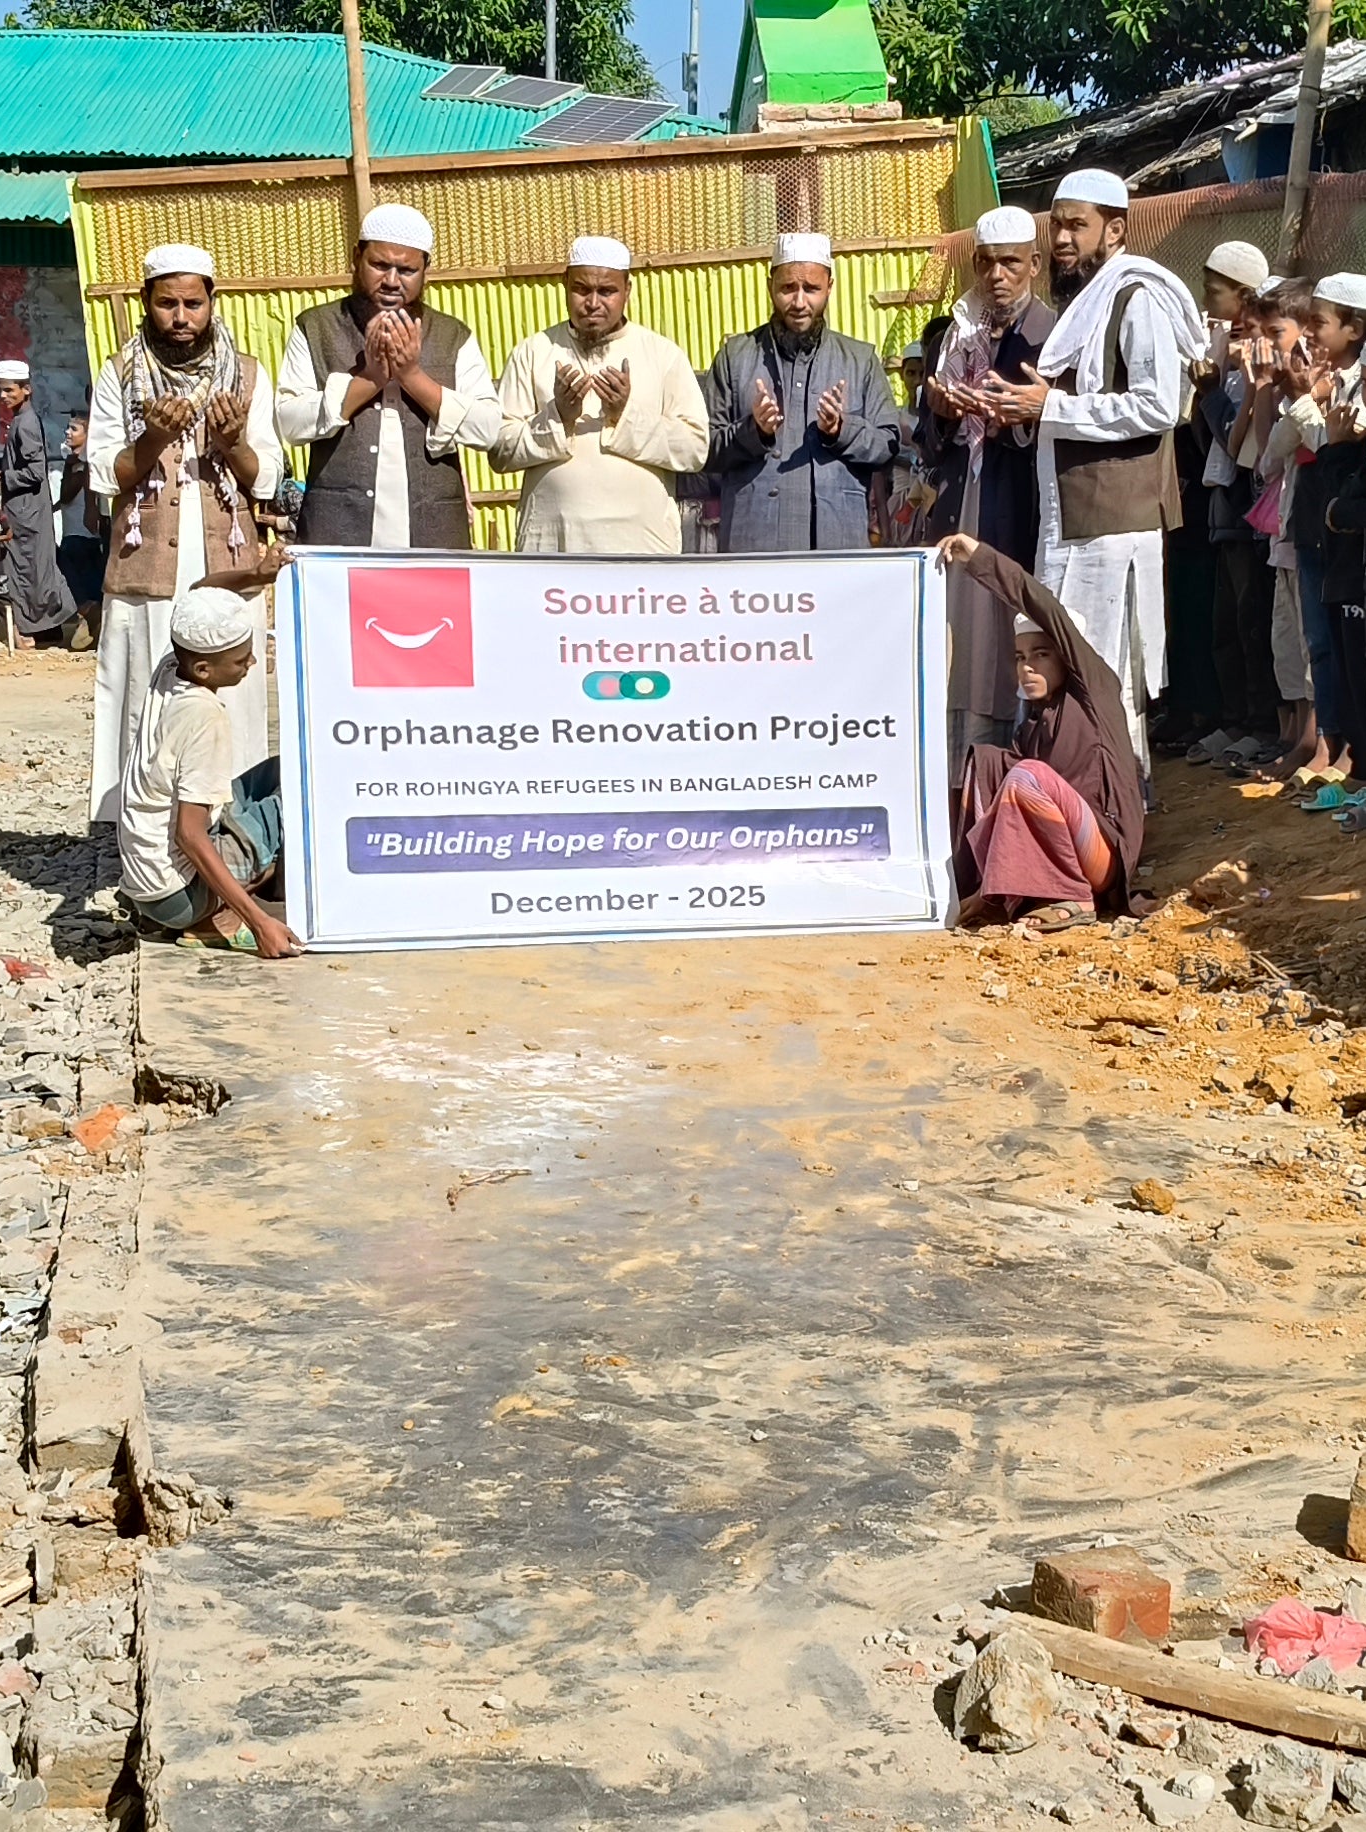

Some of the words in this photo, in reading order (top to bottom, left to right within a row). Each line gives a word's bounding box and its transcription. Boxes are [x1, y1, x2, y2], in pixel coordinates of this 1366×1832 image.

[544, 587, 687, 615] Sourire
[699, 587, 721, 615] à
[729, 589, 816, 615] tous
[559, 633, 814, 663] international
[332, 719, 540, 752] Orphanage
[551, 715, 758, 744] Renovation
[770, 713, 897, 747] Project
[355, 782, 399, 797] FOR
[405, 780, 521, 797] ROHINGYA
[526, 778, 636, 794] REFUGEES
[641, 778, 663, 793] IN
[669, 775, 812, 792] BANGLADESH
[818, 773, 878, 790] CAMP
[366, 831, 514, 859] "Building
[521, 830, 606, 857] Hope
[612, 827, 660, 851] for
[666, 827, 724, 850] Our
[729, 823, 875, 853] Orphans"
[490, 889, 660, 915] December
[688, 885, 766, 909] 2025
